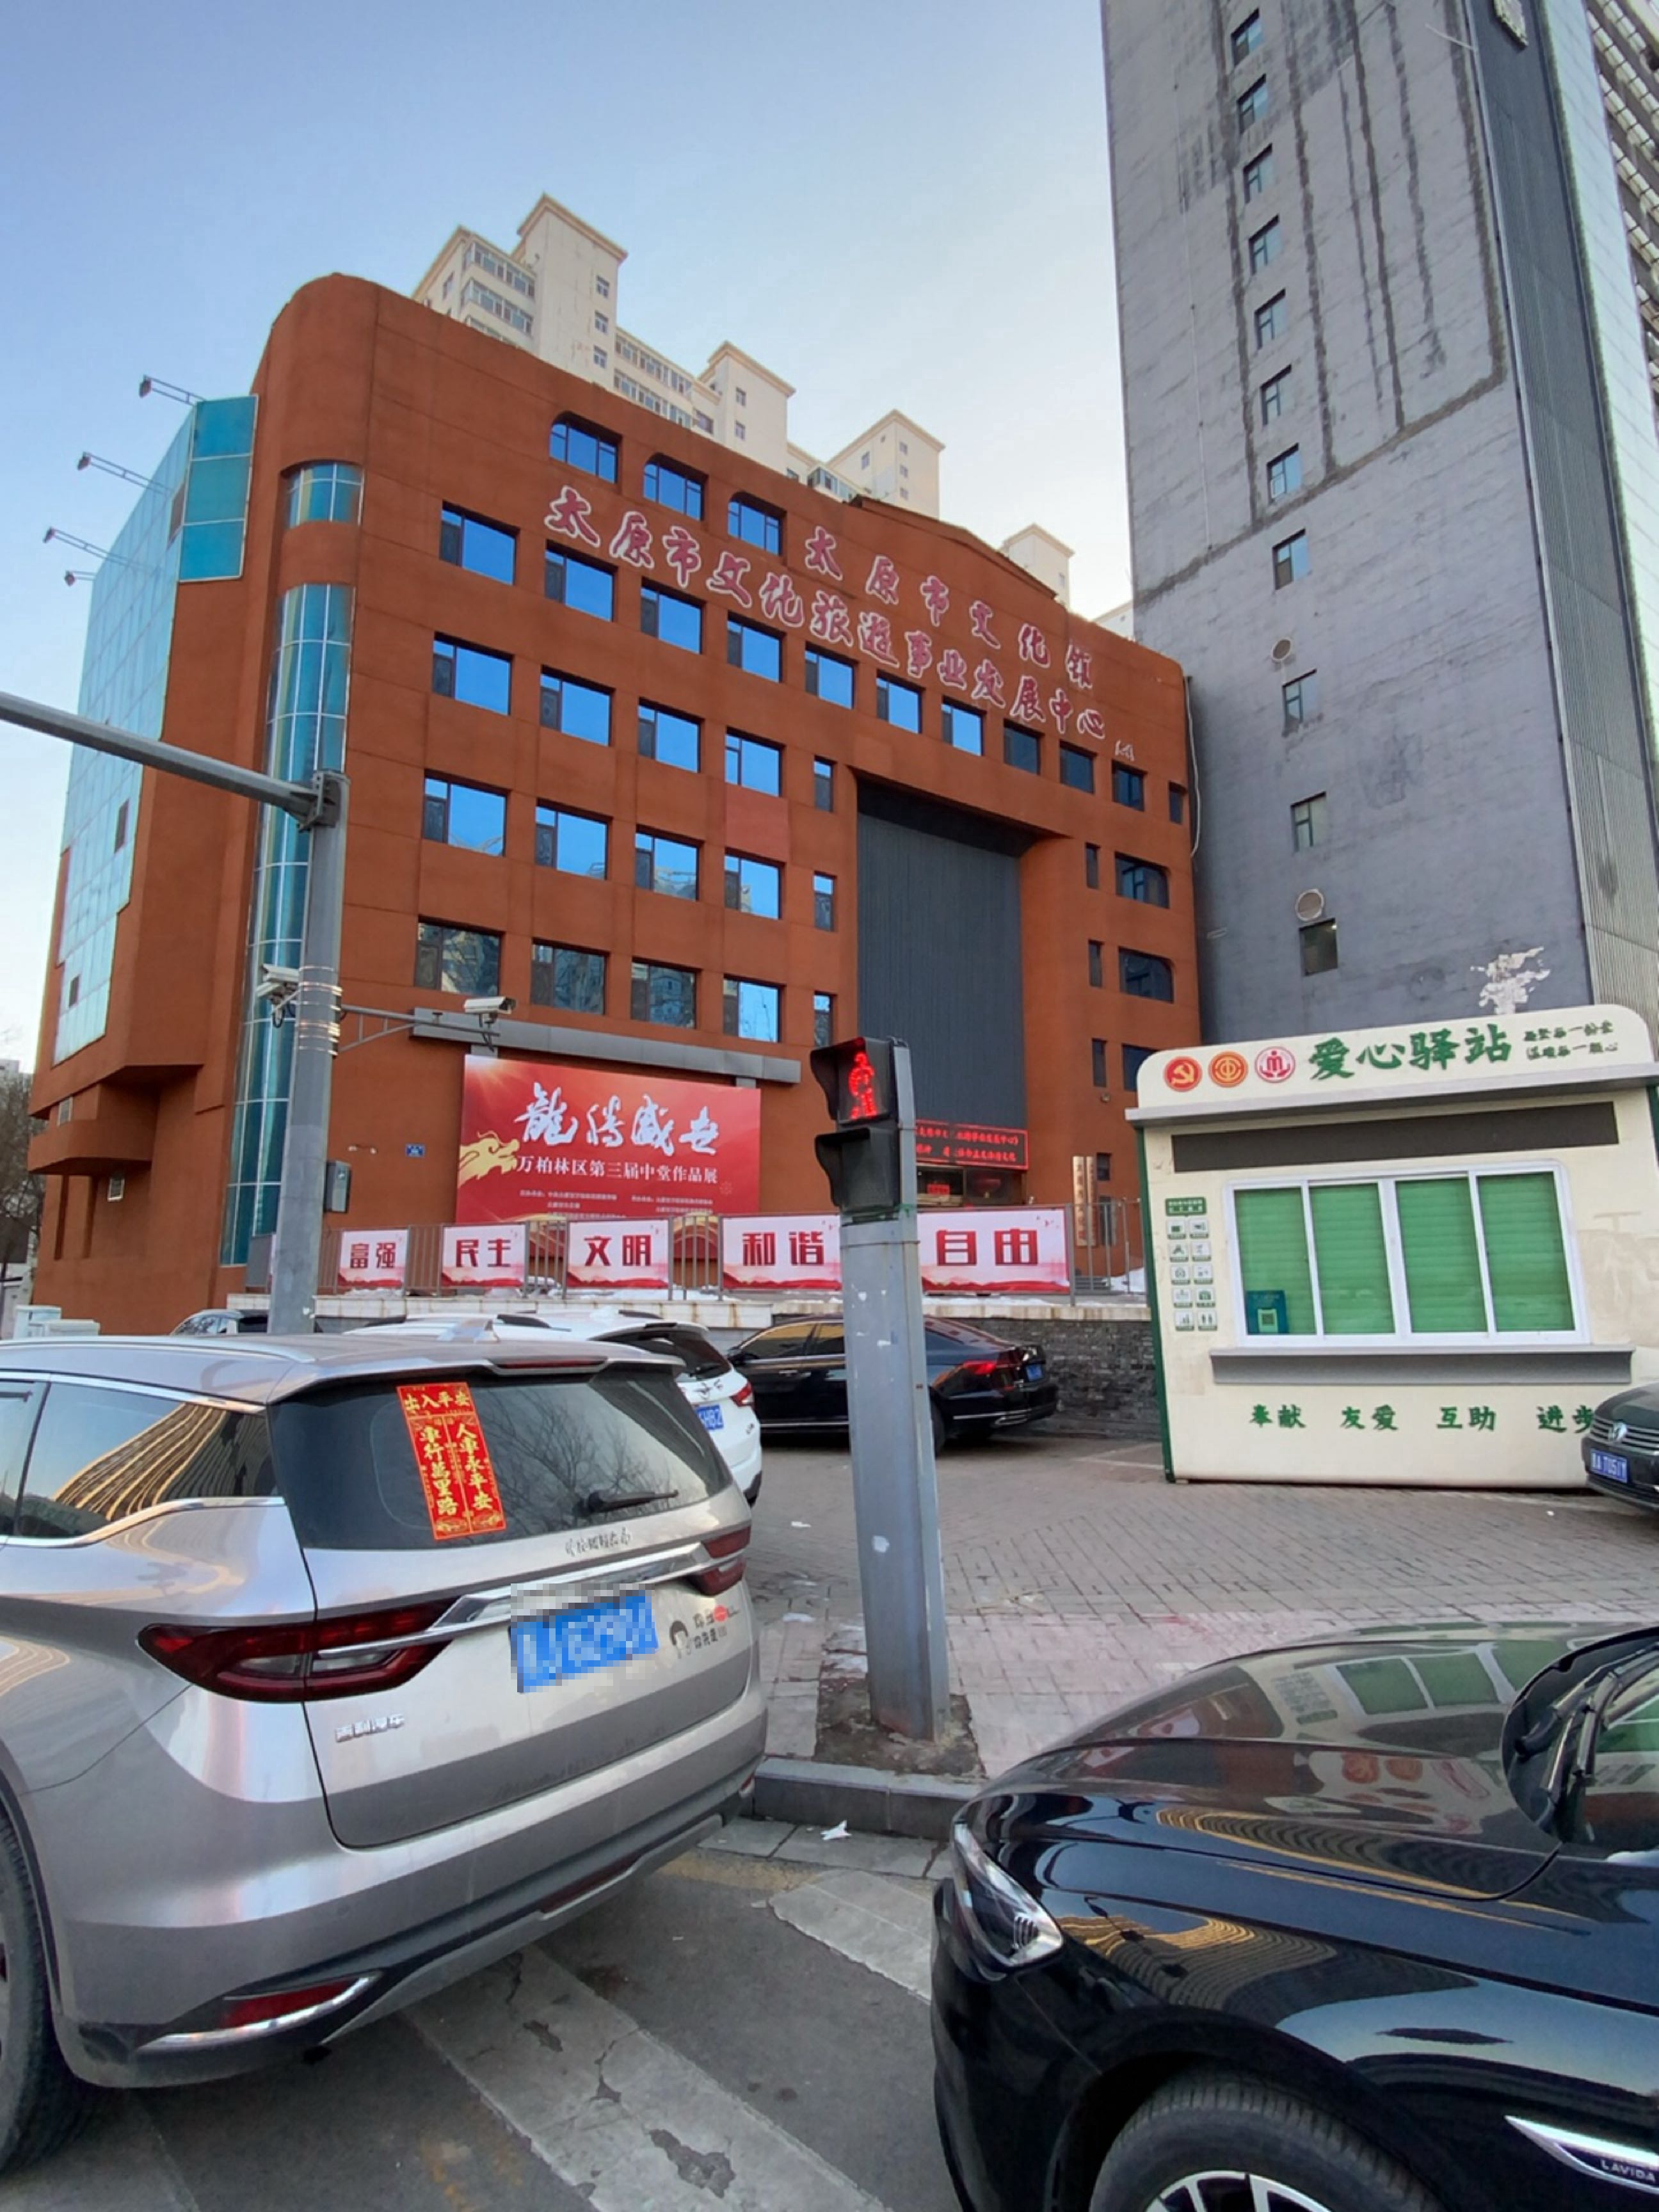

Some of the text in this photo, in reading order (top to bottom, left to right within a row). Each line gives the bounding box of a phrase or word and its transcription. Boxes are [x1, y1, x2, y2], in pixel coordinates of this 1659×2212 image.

[1309, 1023, 1512, 1080] 爱心驿站
[517, 1155, 718, 1184] 万柏林区第三届中堂作品展
[350, 1242, 397, 1269] 富强
[455, 1238, 512, 1268] 民主
[584, 1234, 652, 1267] 文明
[742, 1230, 825, 1267] 和谐
[936, 1228, 1038, 1267] 自由
[403, 1390, 471, 1411] 出入平安
[1249, 1404, 1593, 1433] 奉献 友爱 互助 进步
[1601, 2160, 1655, 2182] LAVIDA
